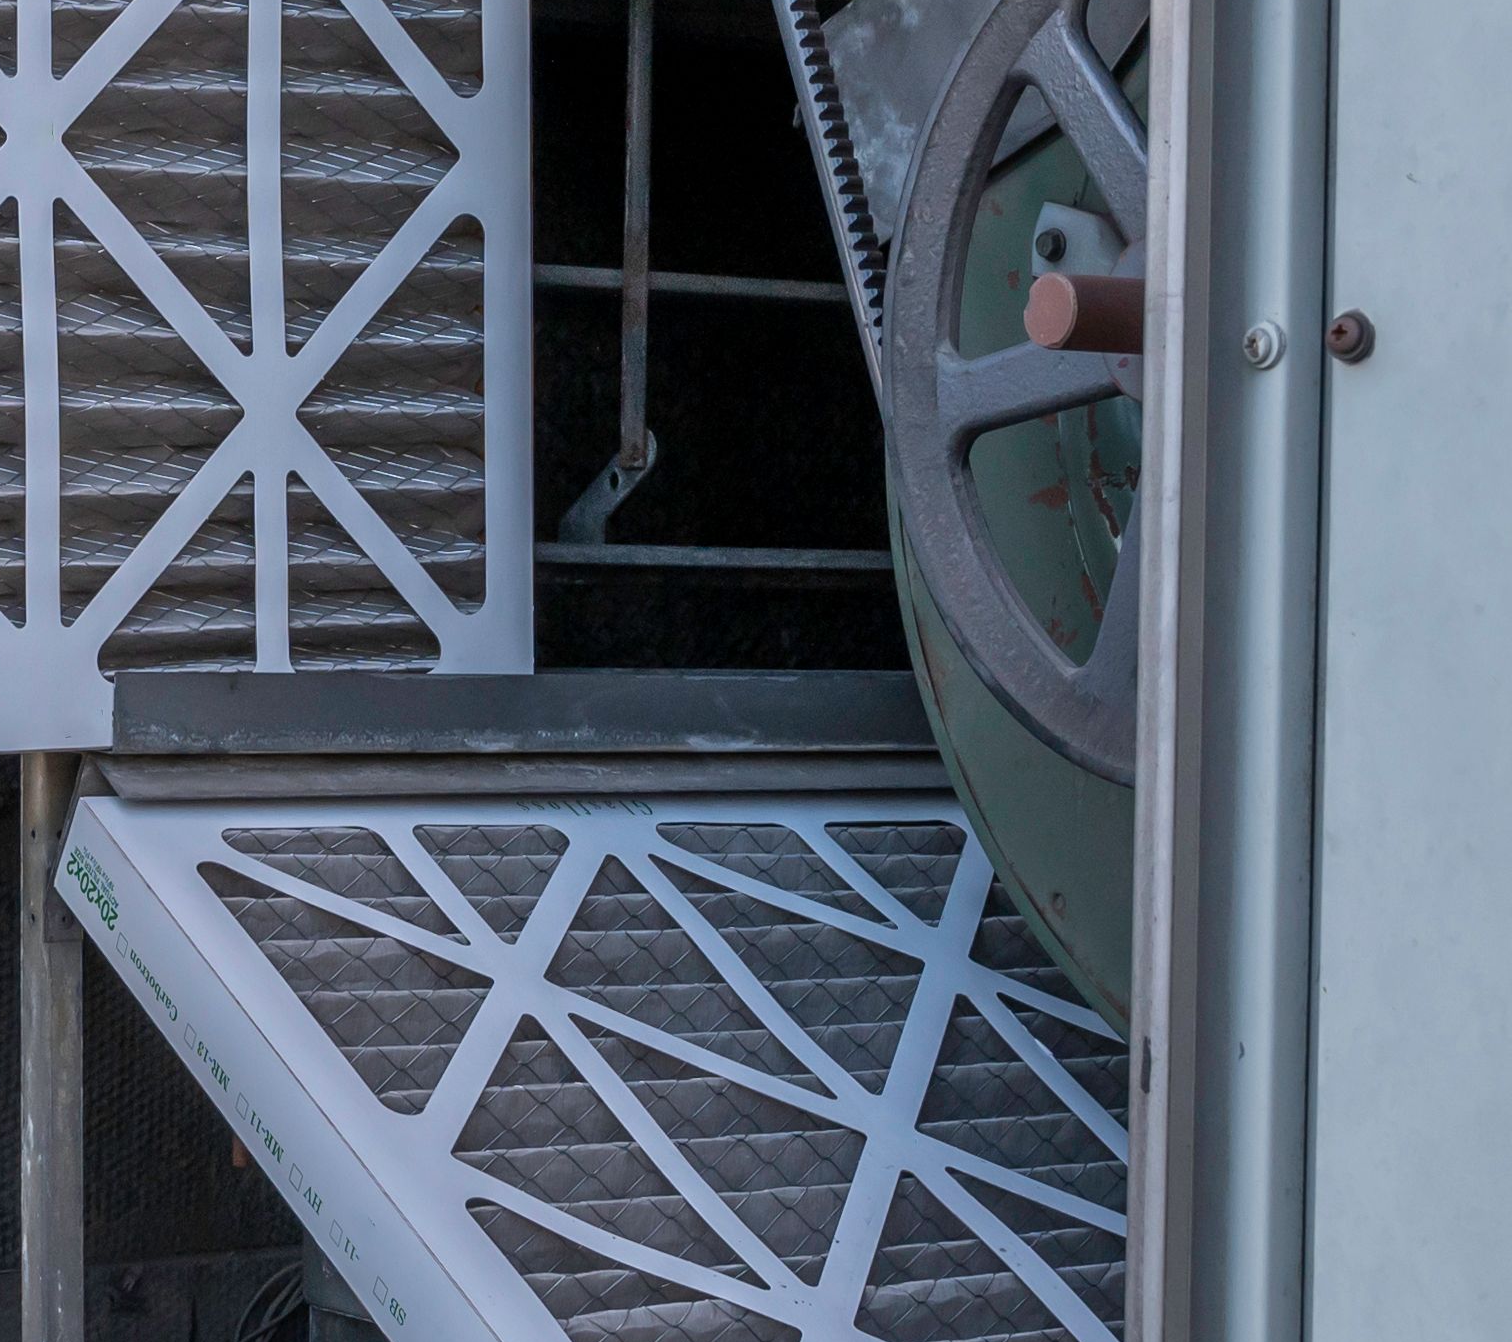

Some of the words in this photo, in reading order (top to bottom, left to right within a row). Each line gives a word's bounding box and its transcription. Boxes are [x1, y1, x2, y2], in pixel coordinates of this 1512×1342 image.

[516, 799, 653, 817] Glasfloss
[66, 852, 119, 931] 20x20x2
[130, 948, 178, 1022] Carbotron
[197, 1040, 232, 1093] MR-13
[250, 1110, 285, 1165] MR-11
[303, 1186, 323, 1216] HV
[389, 1297, 408, 1327] SB
